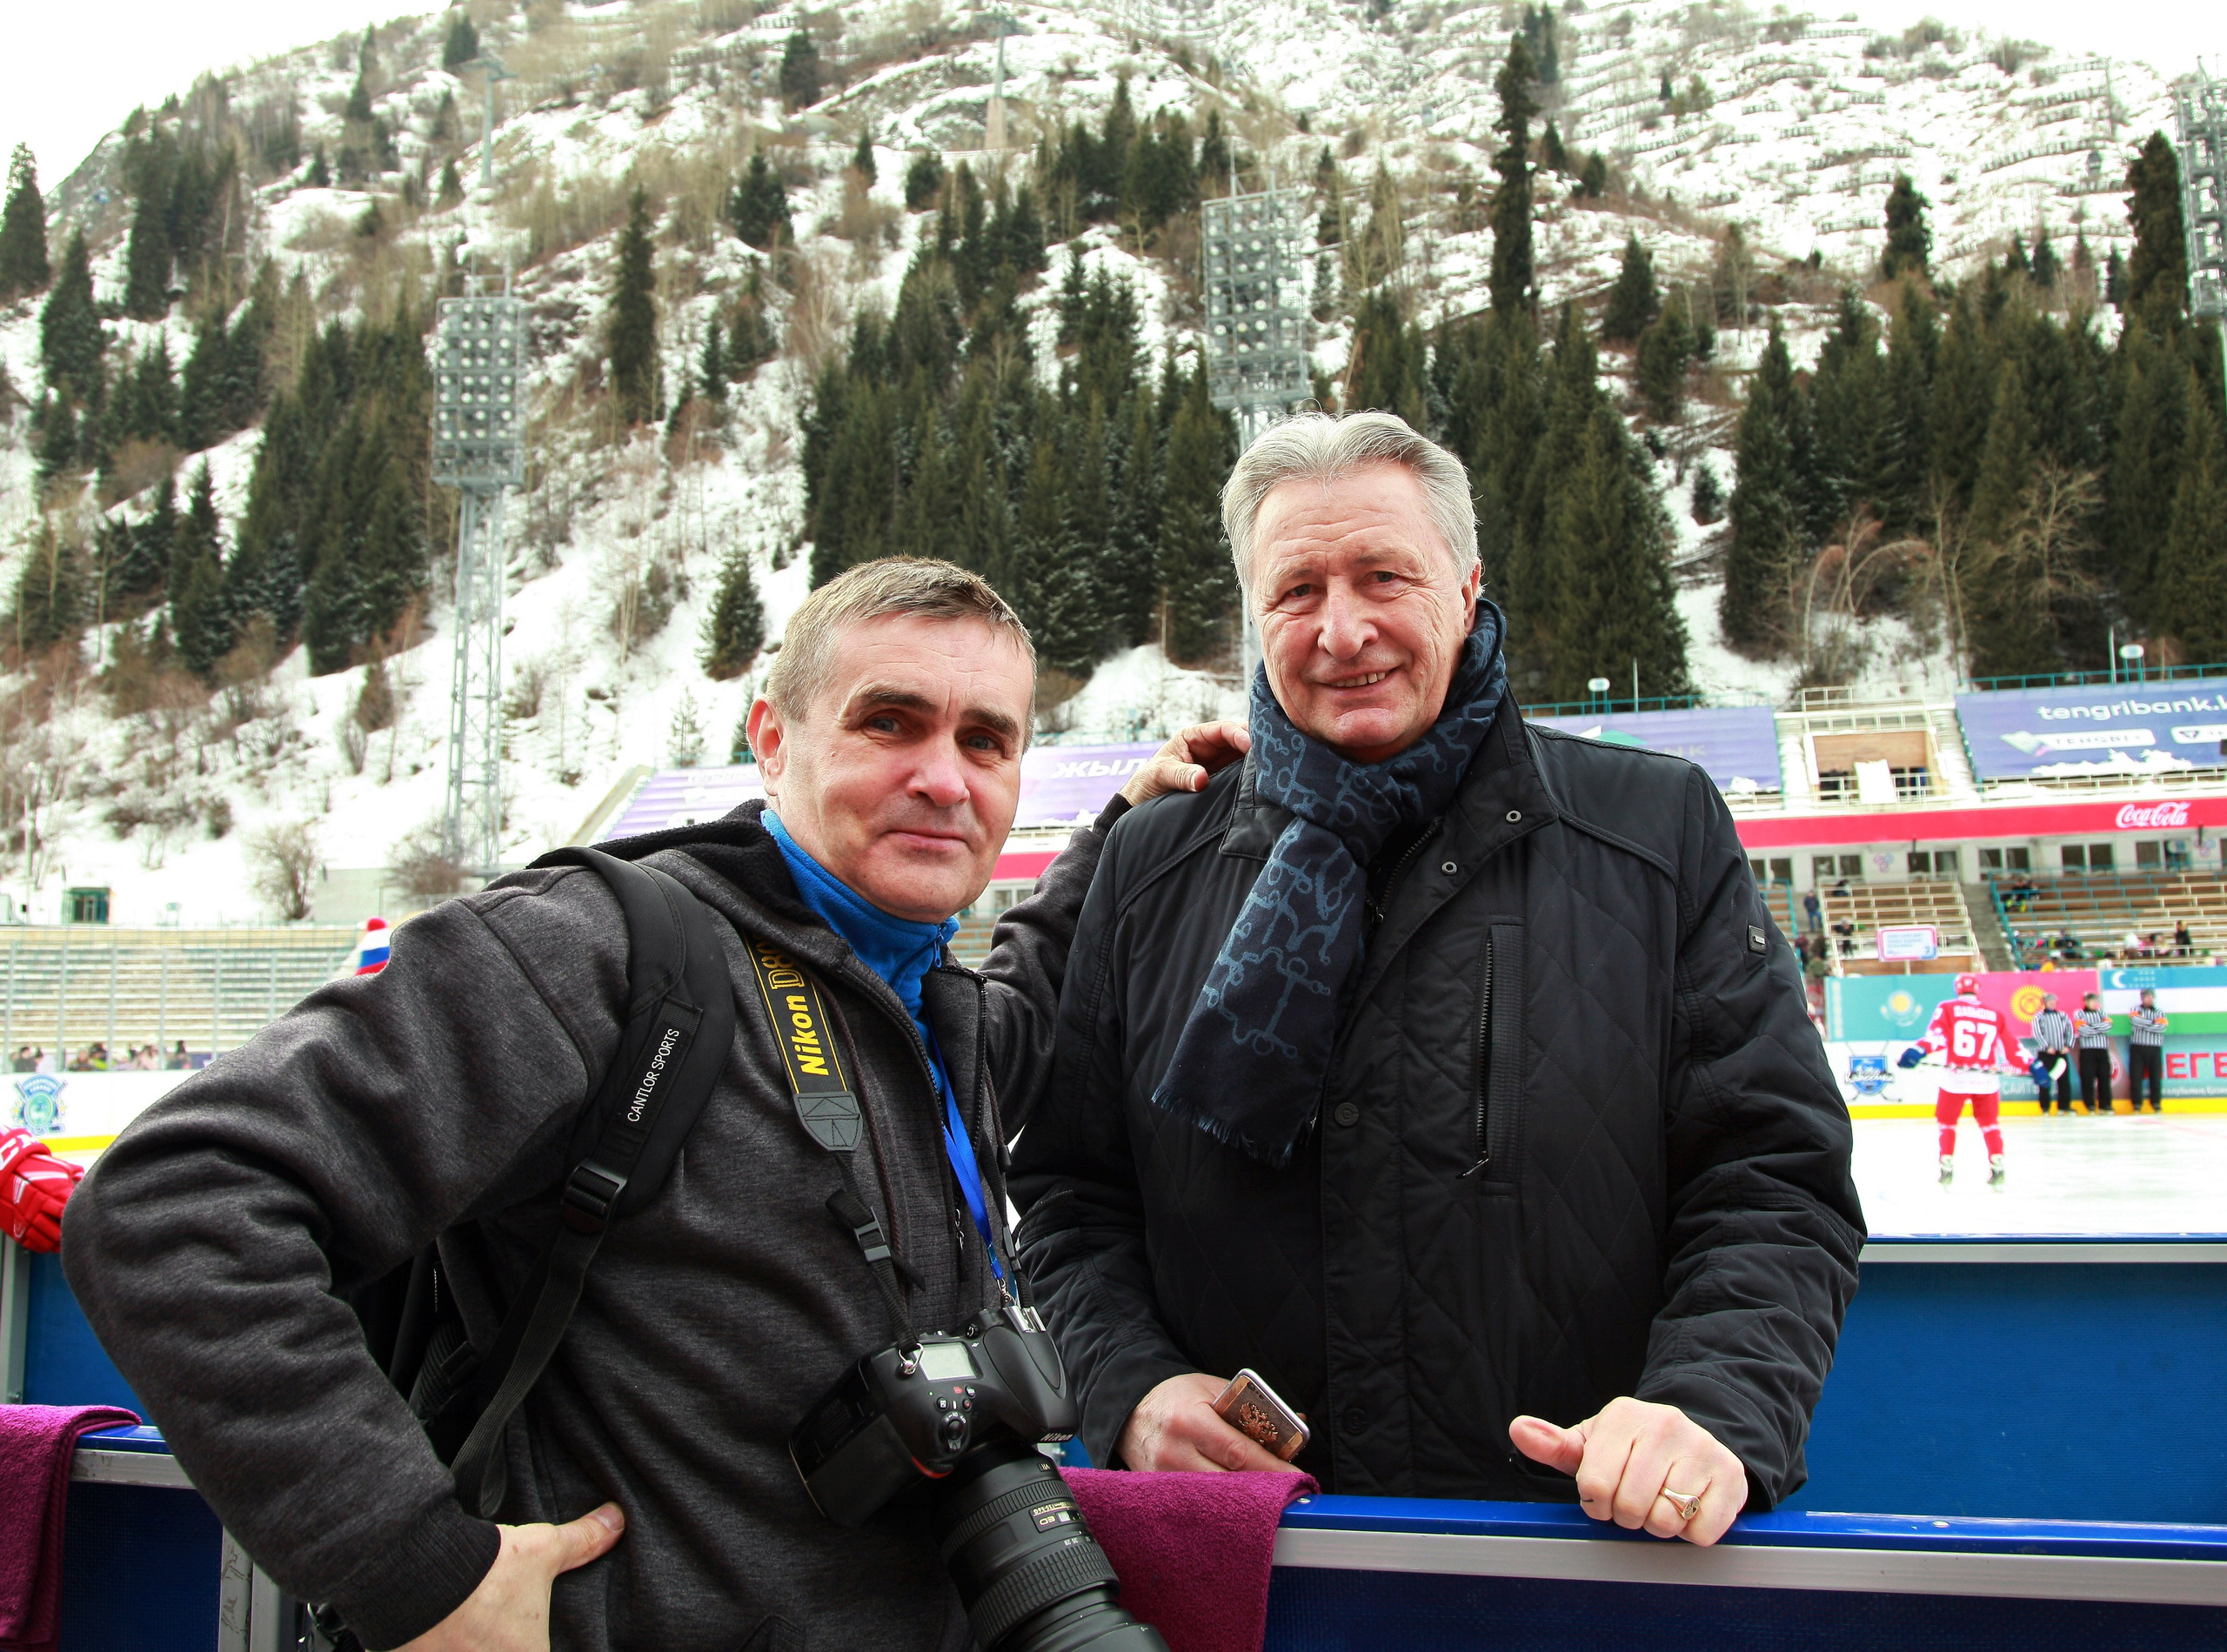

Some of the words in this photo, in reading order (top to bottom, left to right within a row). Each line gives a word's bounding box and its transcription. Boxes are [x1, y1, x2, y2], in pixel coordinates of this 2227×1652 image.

[1051, 758, 1150, 779] ЖЫЛ
[786, 995, 830, 1077] Nikon
[1953, 1020, 1997, 1060] 67
[627, 1071, 660, 1122] CANTLOR
[651, 1028, 680, 1070] SPORTS
[2143, 1052, 2227, 1080] ЕГЕ
[1040, 1433, 1073, 1441] Nikon
[1039, 1515, 1056, 1526] ED
